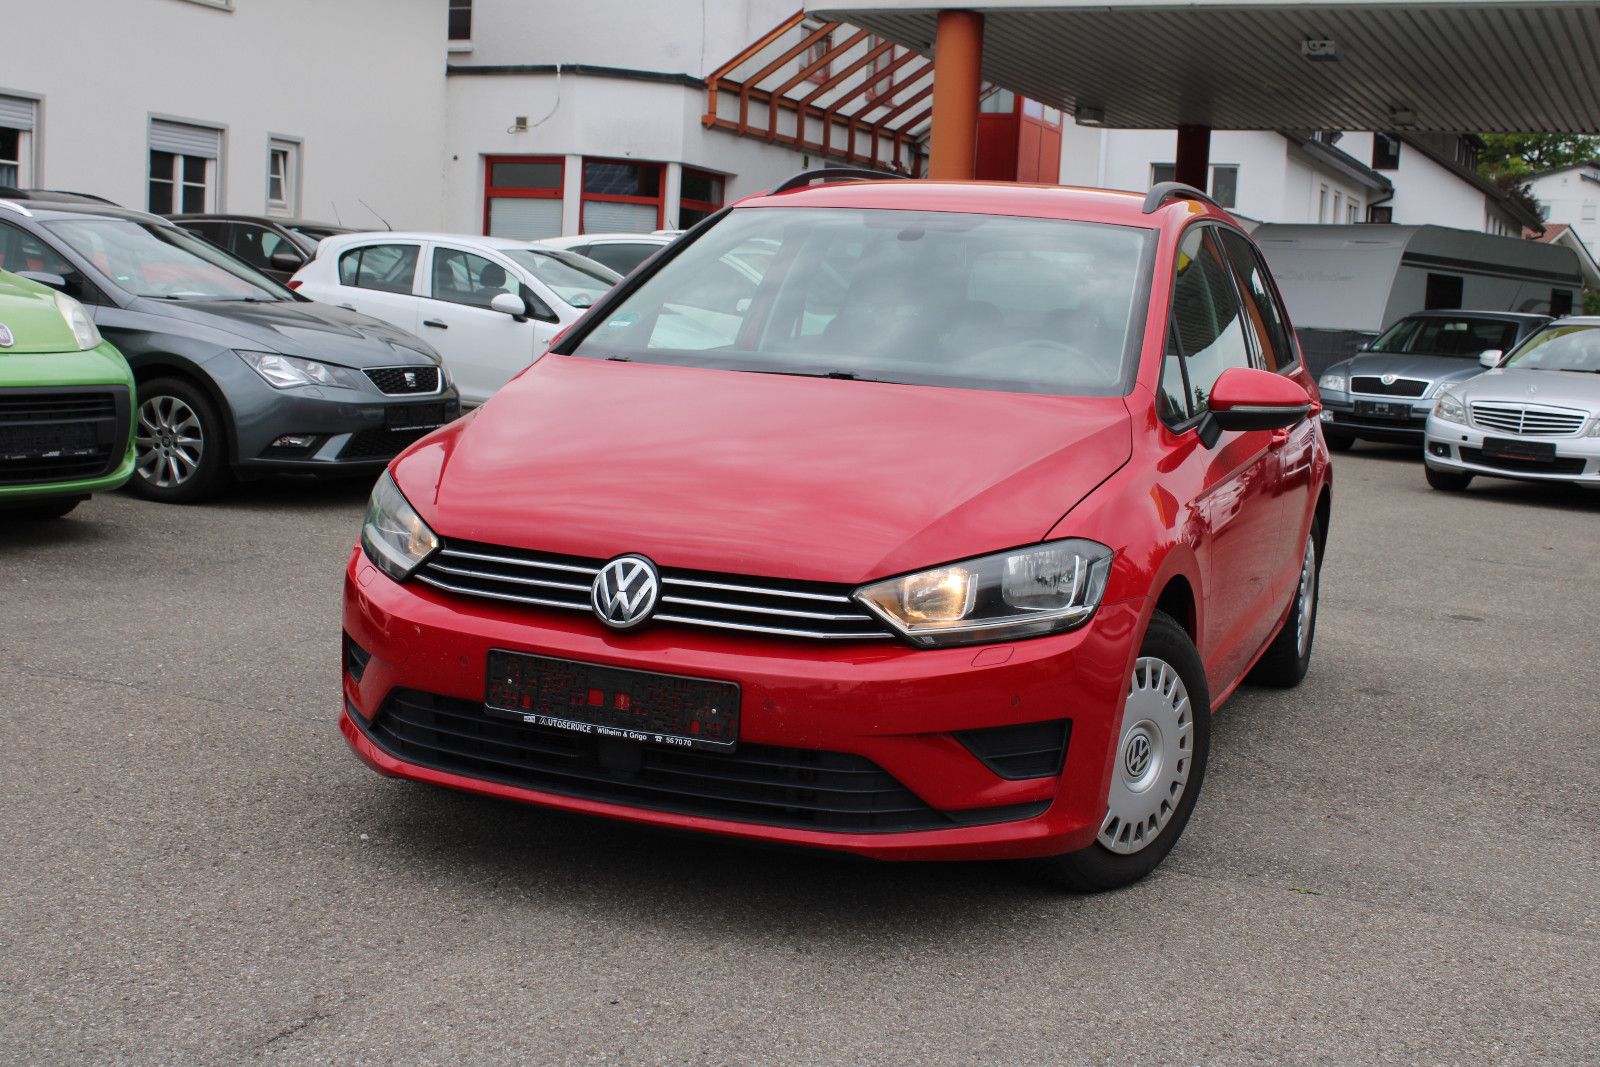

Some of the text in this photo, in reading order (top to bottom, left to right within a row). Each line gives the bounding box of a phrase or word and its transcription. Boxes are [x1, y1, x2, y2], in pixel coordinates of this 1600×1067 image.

[593, 558, 658, 627] VW
[538, 716, 592, 734] AUTOSERVICE
[596, 726, 622, 737] Wilhelm
[623, 730, 628, 738] &
[629, 731, 647, 741] Grigo
